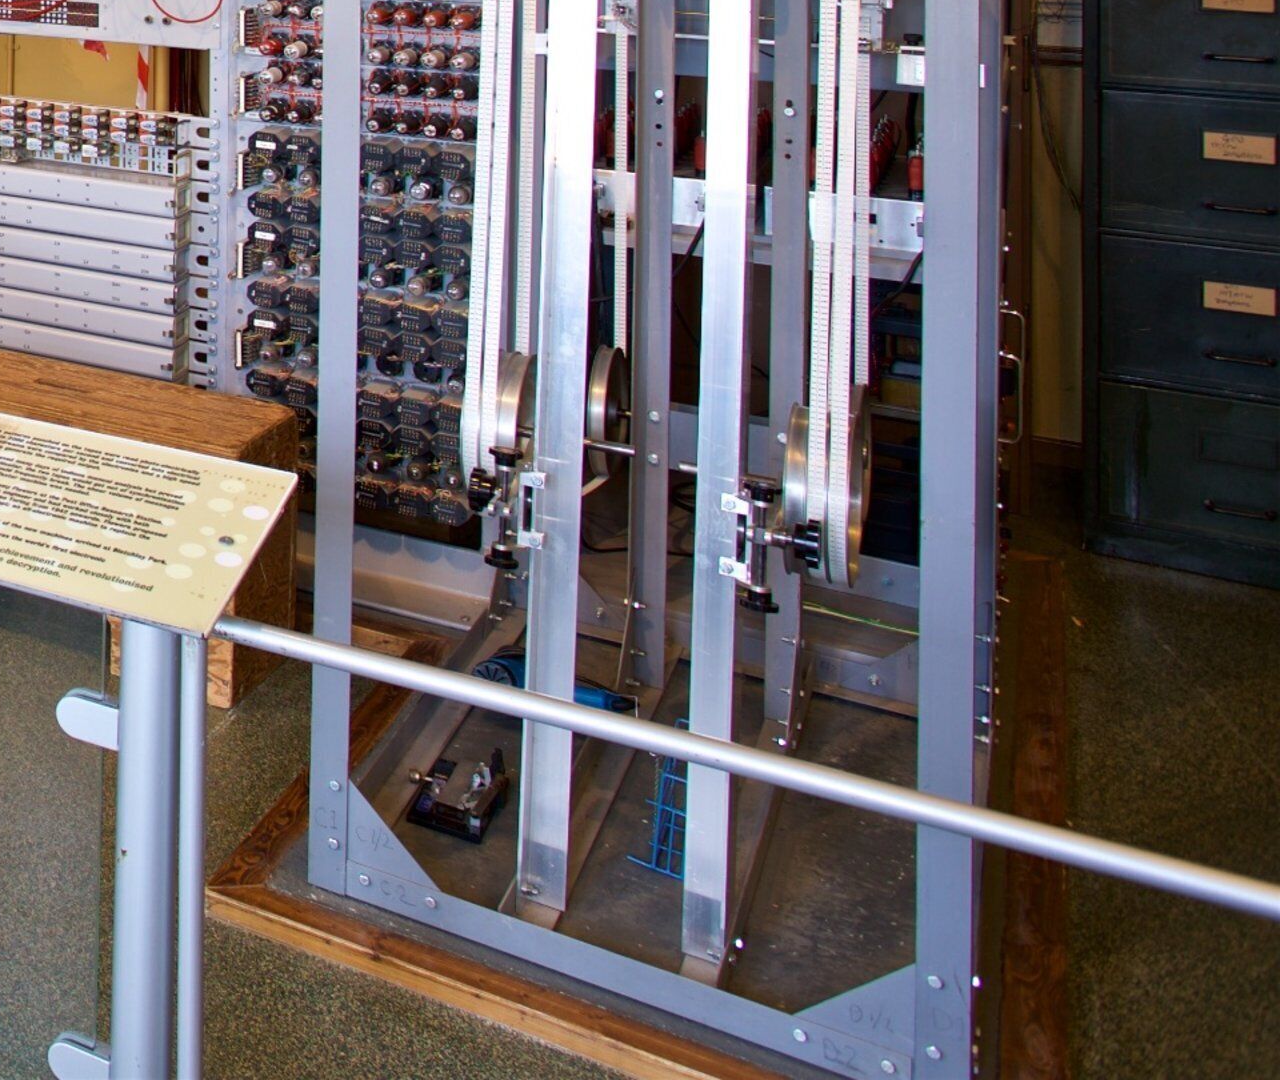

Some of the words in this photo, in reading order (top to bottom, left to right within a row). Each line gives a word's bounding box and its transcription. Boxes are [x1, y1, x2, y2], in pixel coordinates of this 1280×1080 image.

[6, 558, 61, 578] decryption.
[57, 563, 78, 572] and
[79, 568, 154, 592] revolutionised
